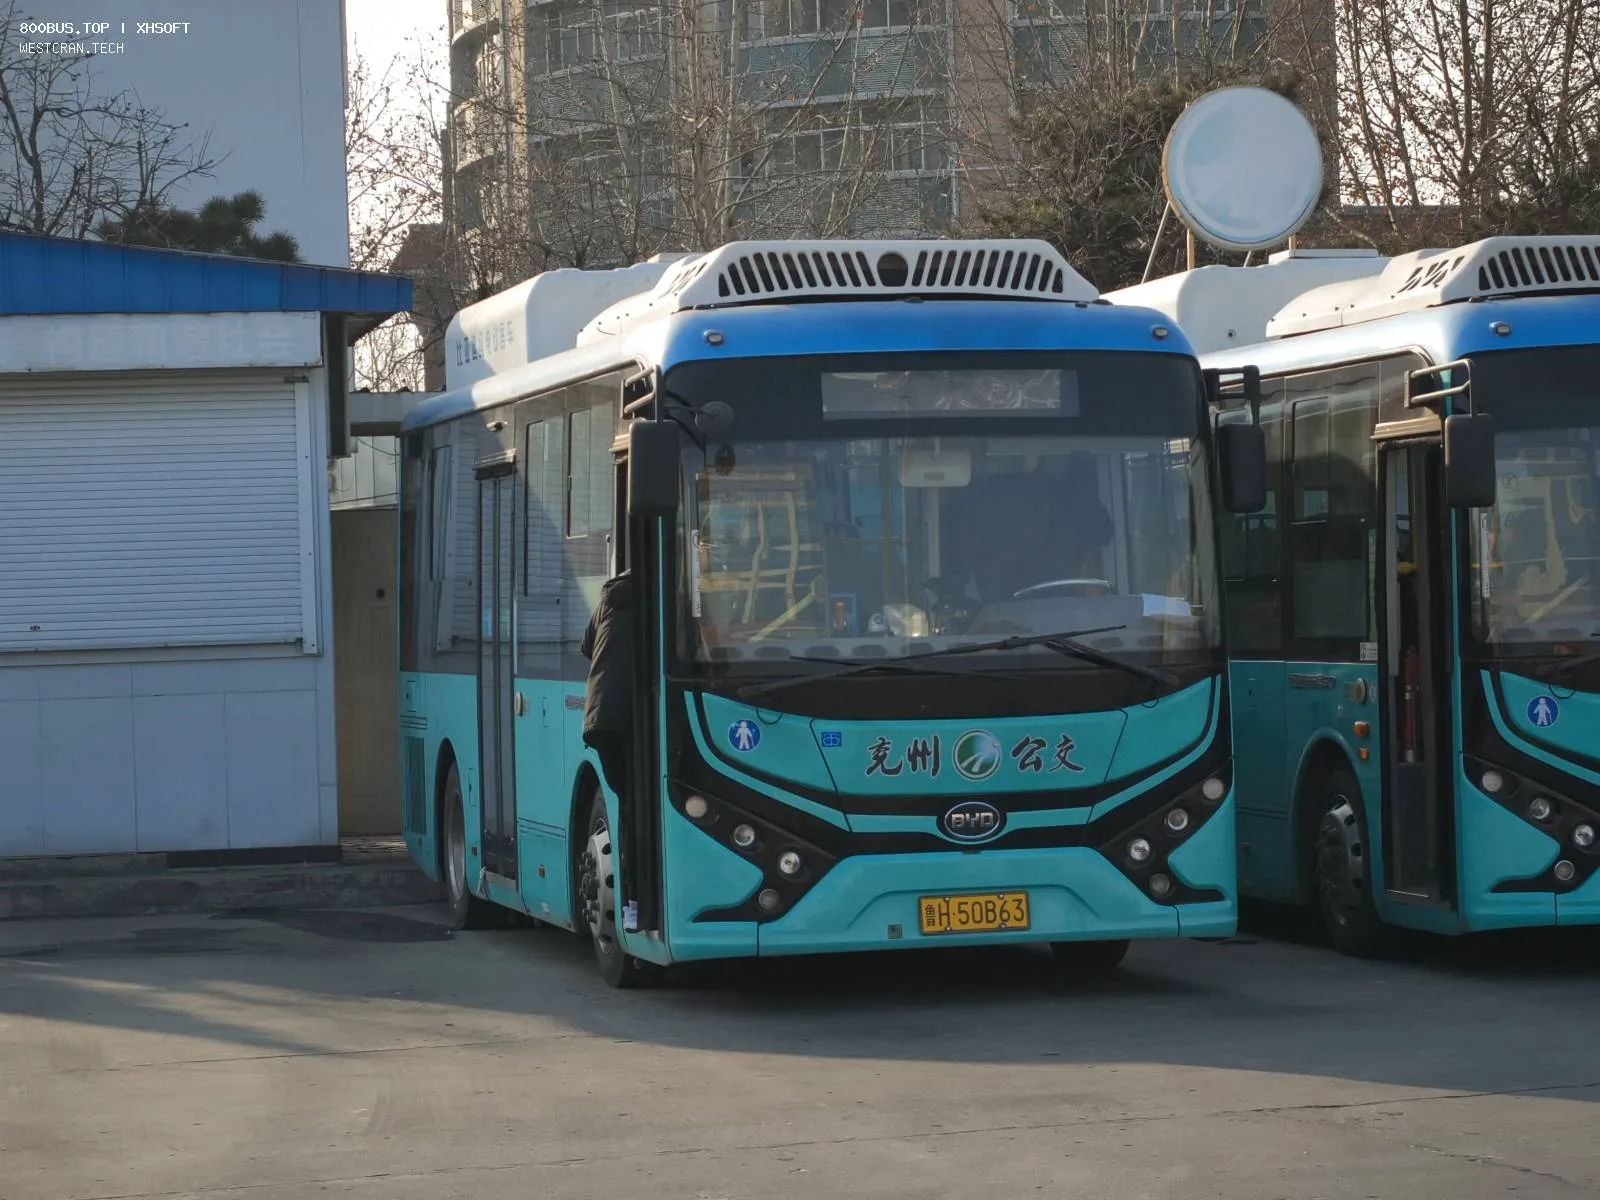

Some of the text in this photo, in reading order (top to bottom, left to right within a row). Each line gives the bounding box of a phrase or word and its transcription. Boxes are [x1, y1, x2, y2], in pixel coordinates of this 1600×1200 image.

[866, 734, 1084, 776] 兖州 公交
[951, 811, 993, 828] BYD
